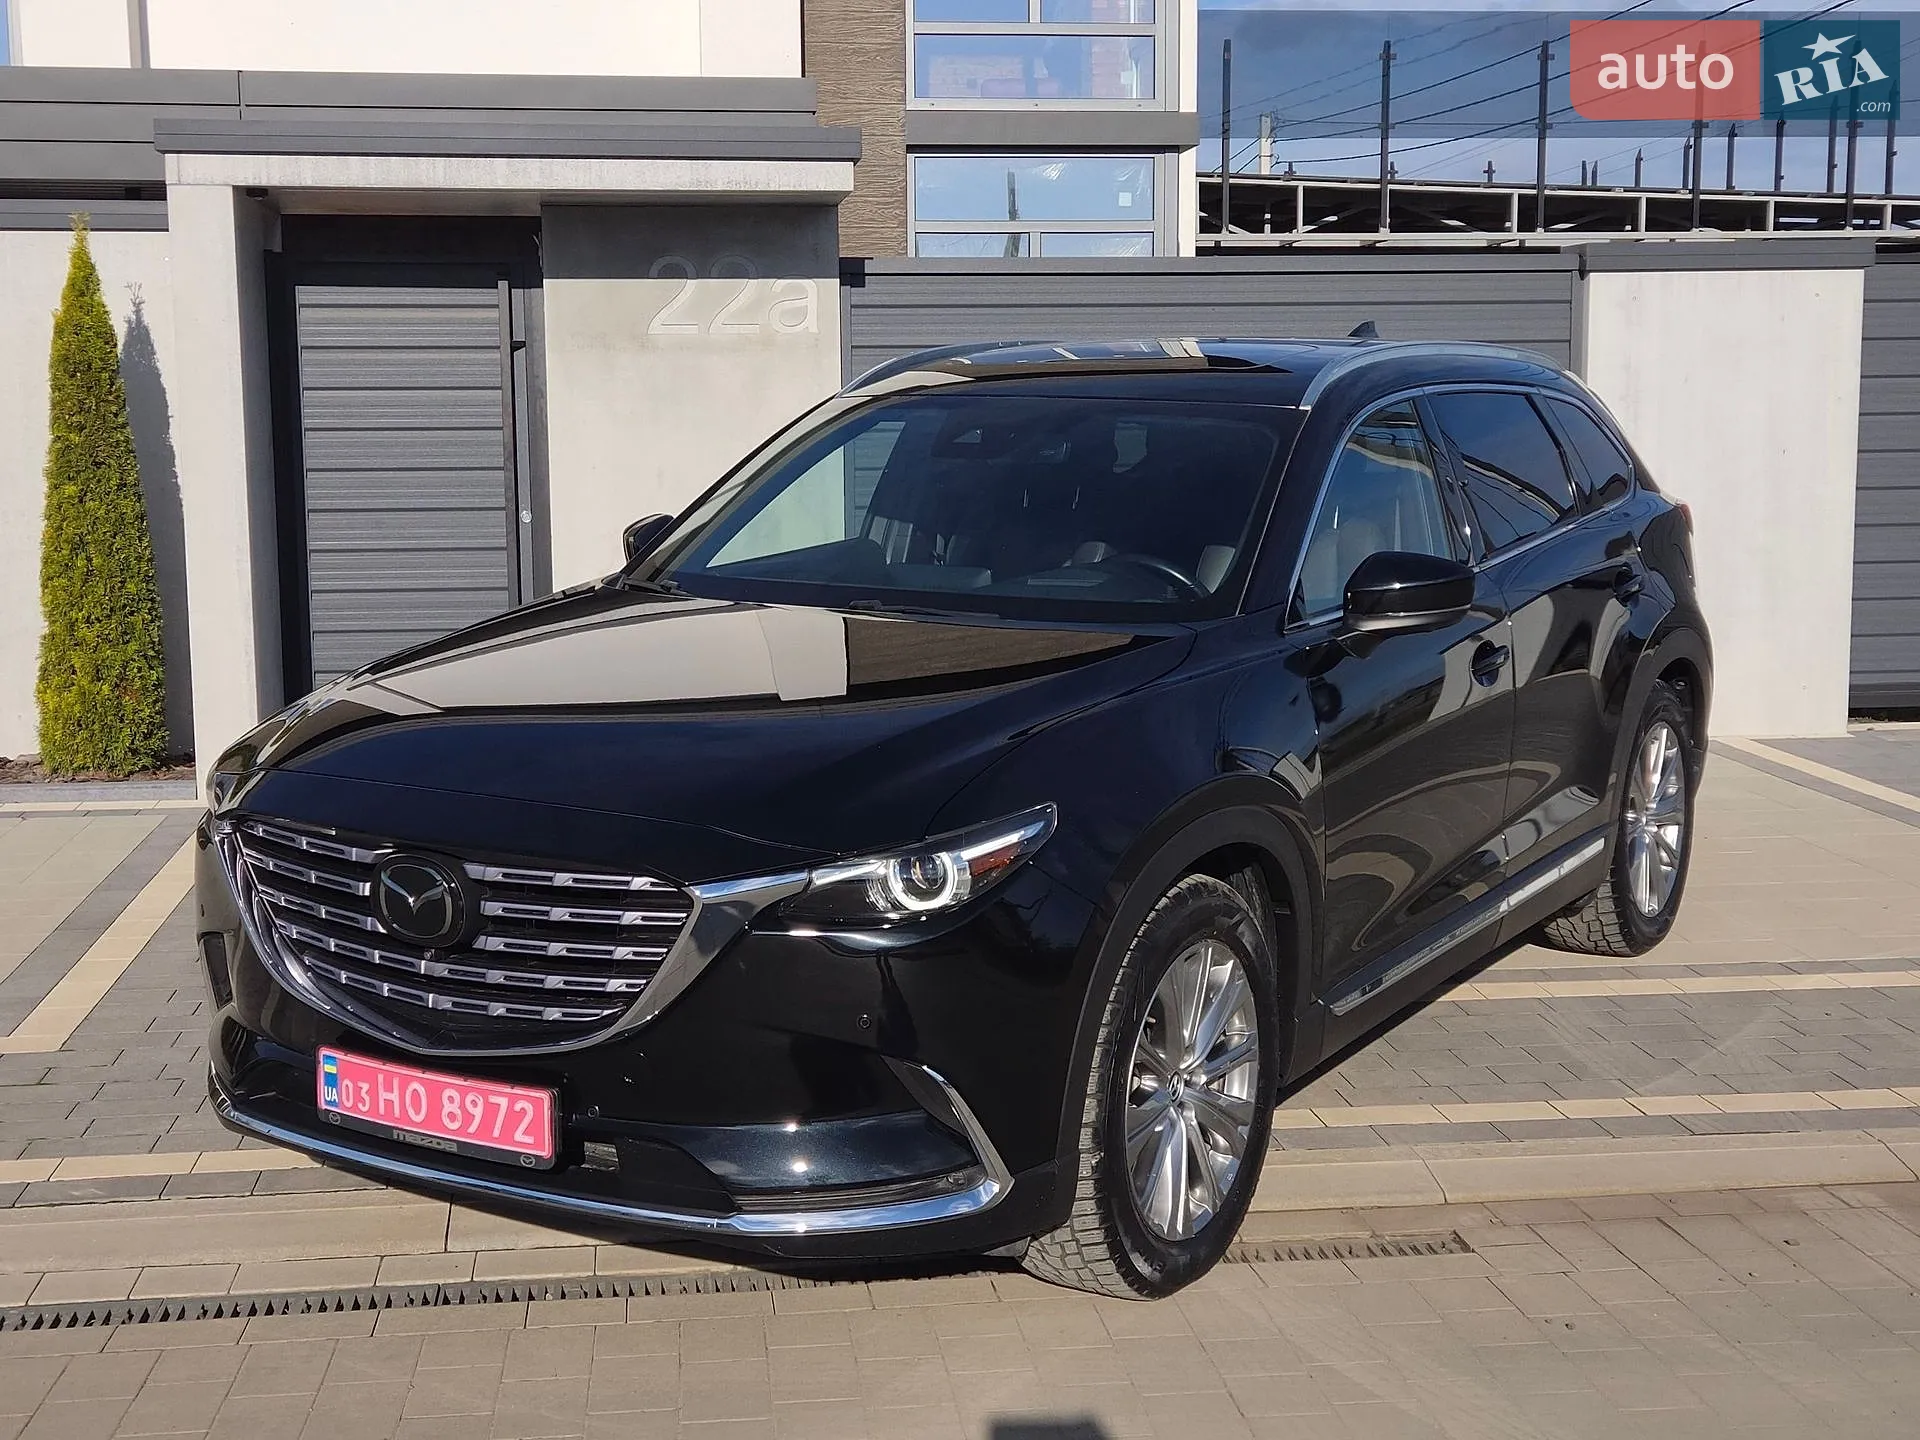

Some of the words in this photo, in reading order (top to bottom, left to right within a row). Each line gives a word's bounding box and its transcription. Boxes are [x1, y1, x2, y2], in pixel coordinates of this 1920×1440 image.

[648, 254, 819, 334] 22a
[324, 1086, 339, 1103] UA
[440, 1087, 535, 1144] 8972
